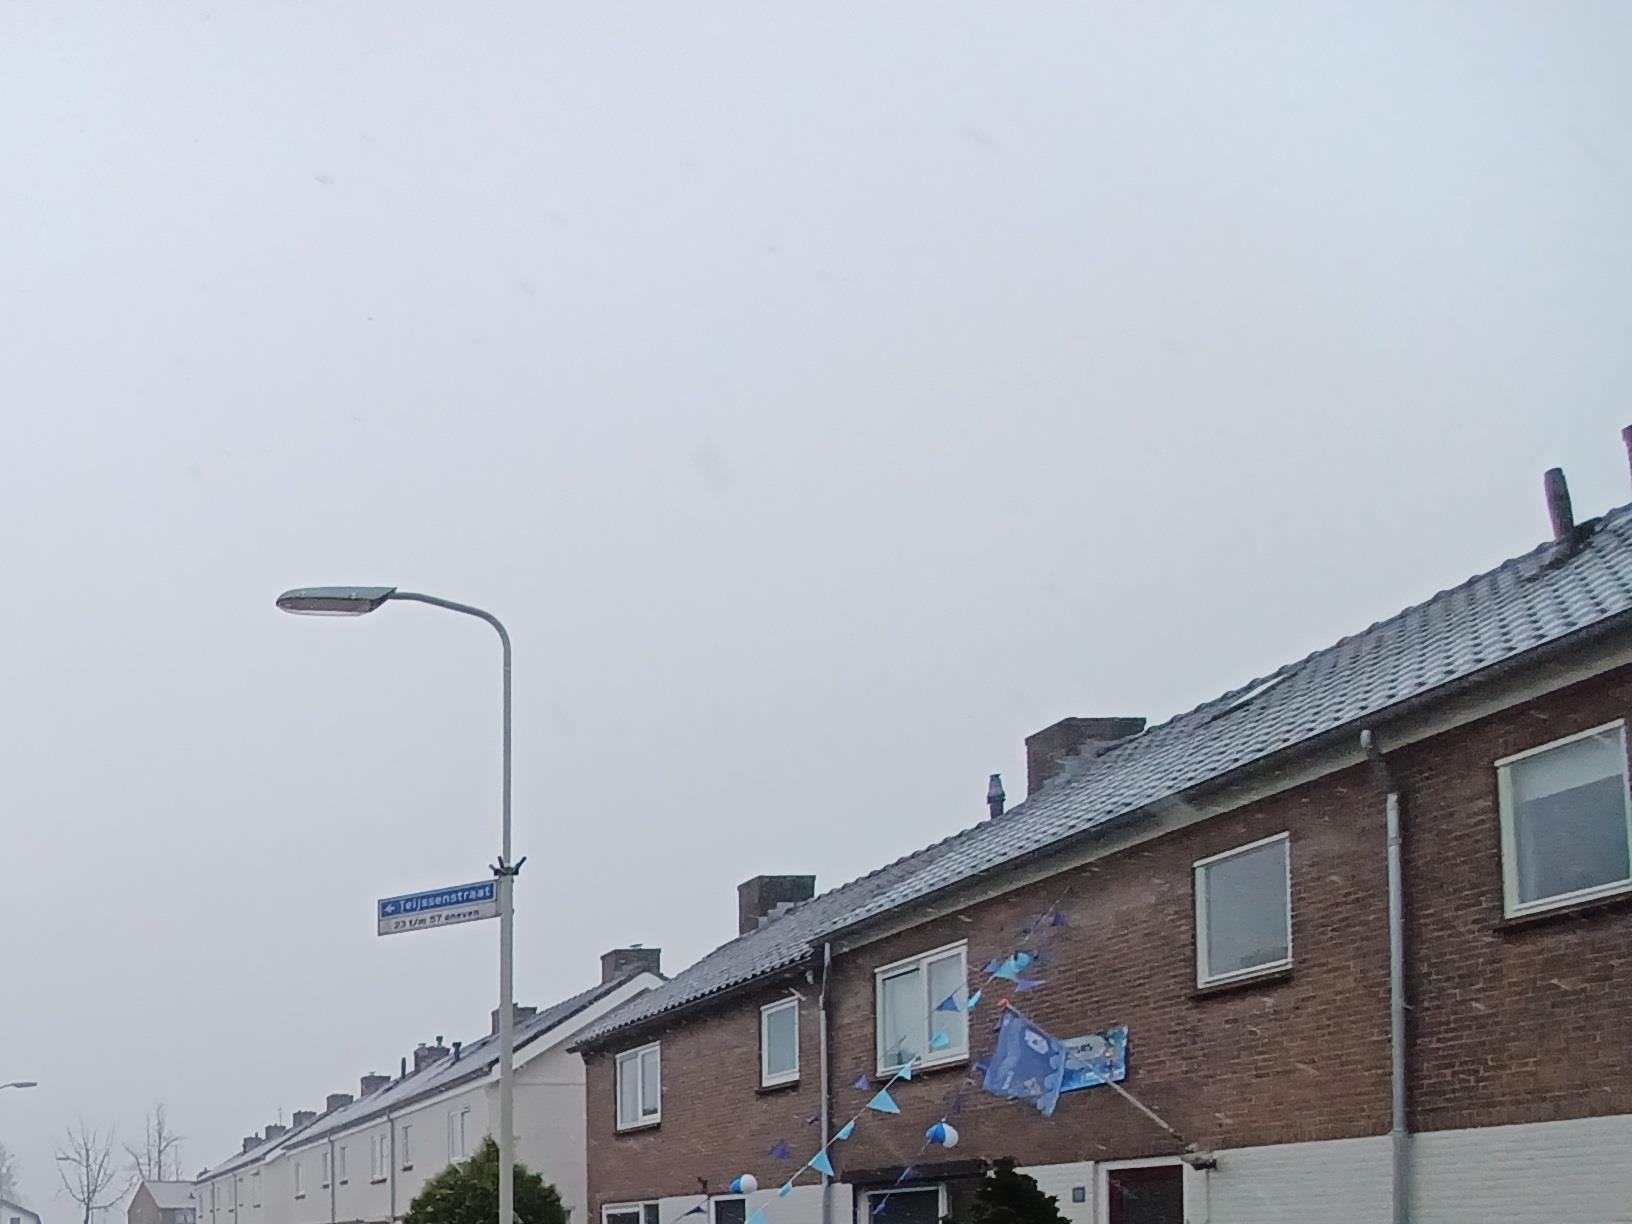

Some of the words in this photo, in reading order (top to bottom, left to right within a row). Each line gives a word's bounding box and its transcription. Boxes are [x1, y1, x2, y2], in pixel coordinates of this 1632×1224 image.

[400, 886, 491, 910] Teijssenstraat
[394, 920, 407, 930] 23
[409, 917, 427, 927] t/m
[444, 909, 480, 921] oneven
